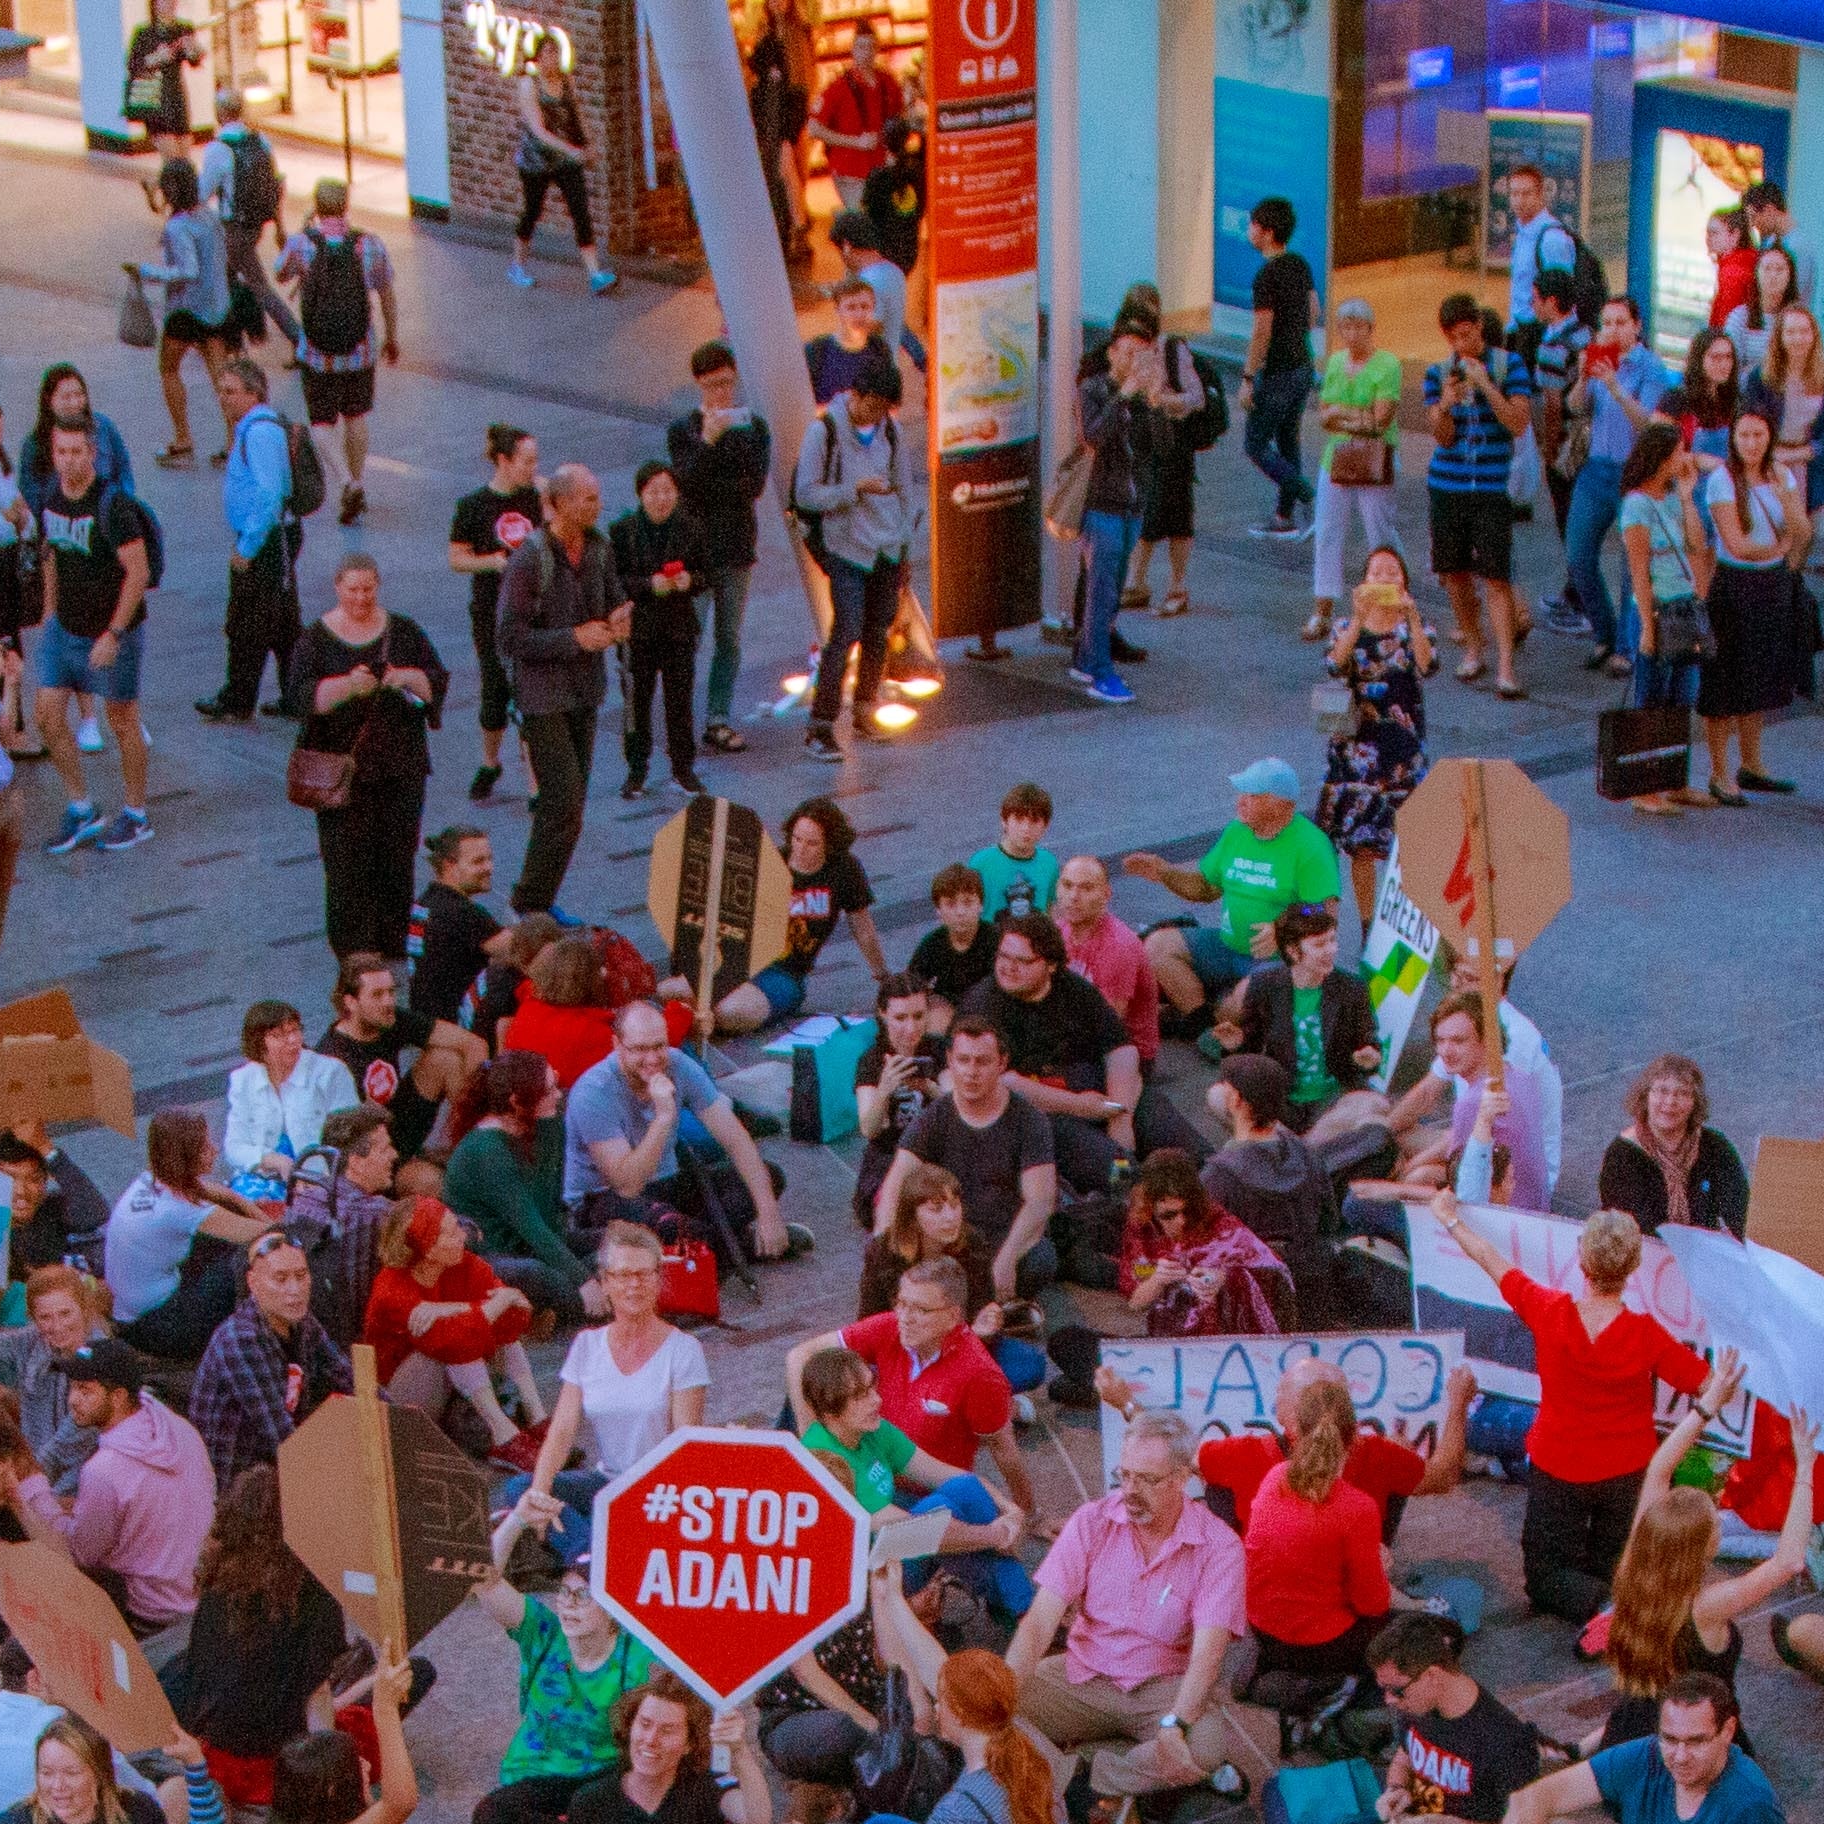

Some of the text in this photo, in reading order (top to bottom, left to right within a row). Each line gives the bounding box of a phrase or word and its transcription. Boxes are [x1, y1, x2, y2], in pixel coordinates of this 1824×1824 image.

[1380, 876, 1435, 955] GREENS
[642, 1484, 819, 1548] #STOP
[636, 1549, 812, 1615] ADANI
